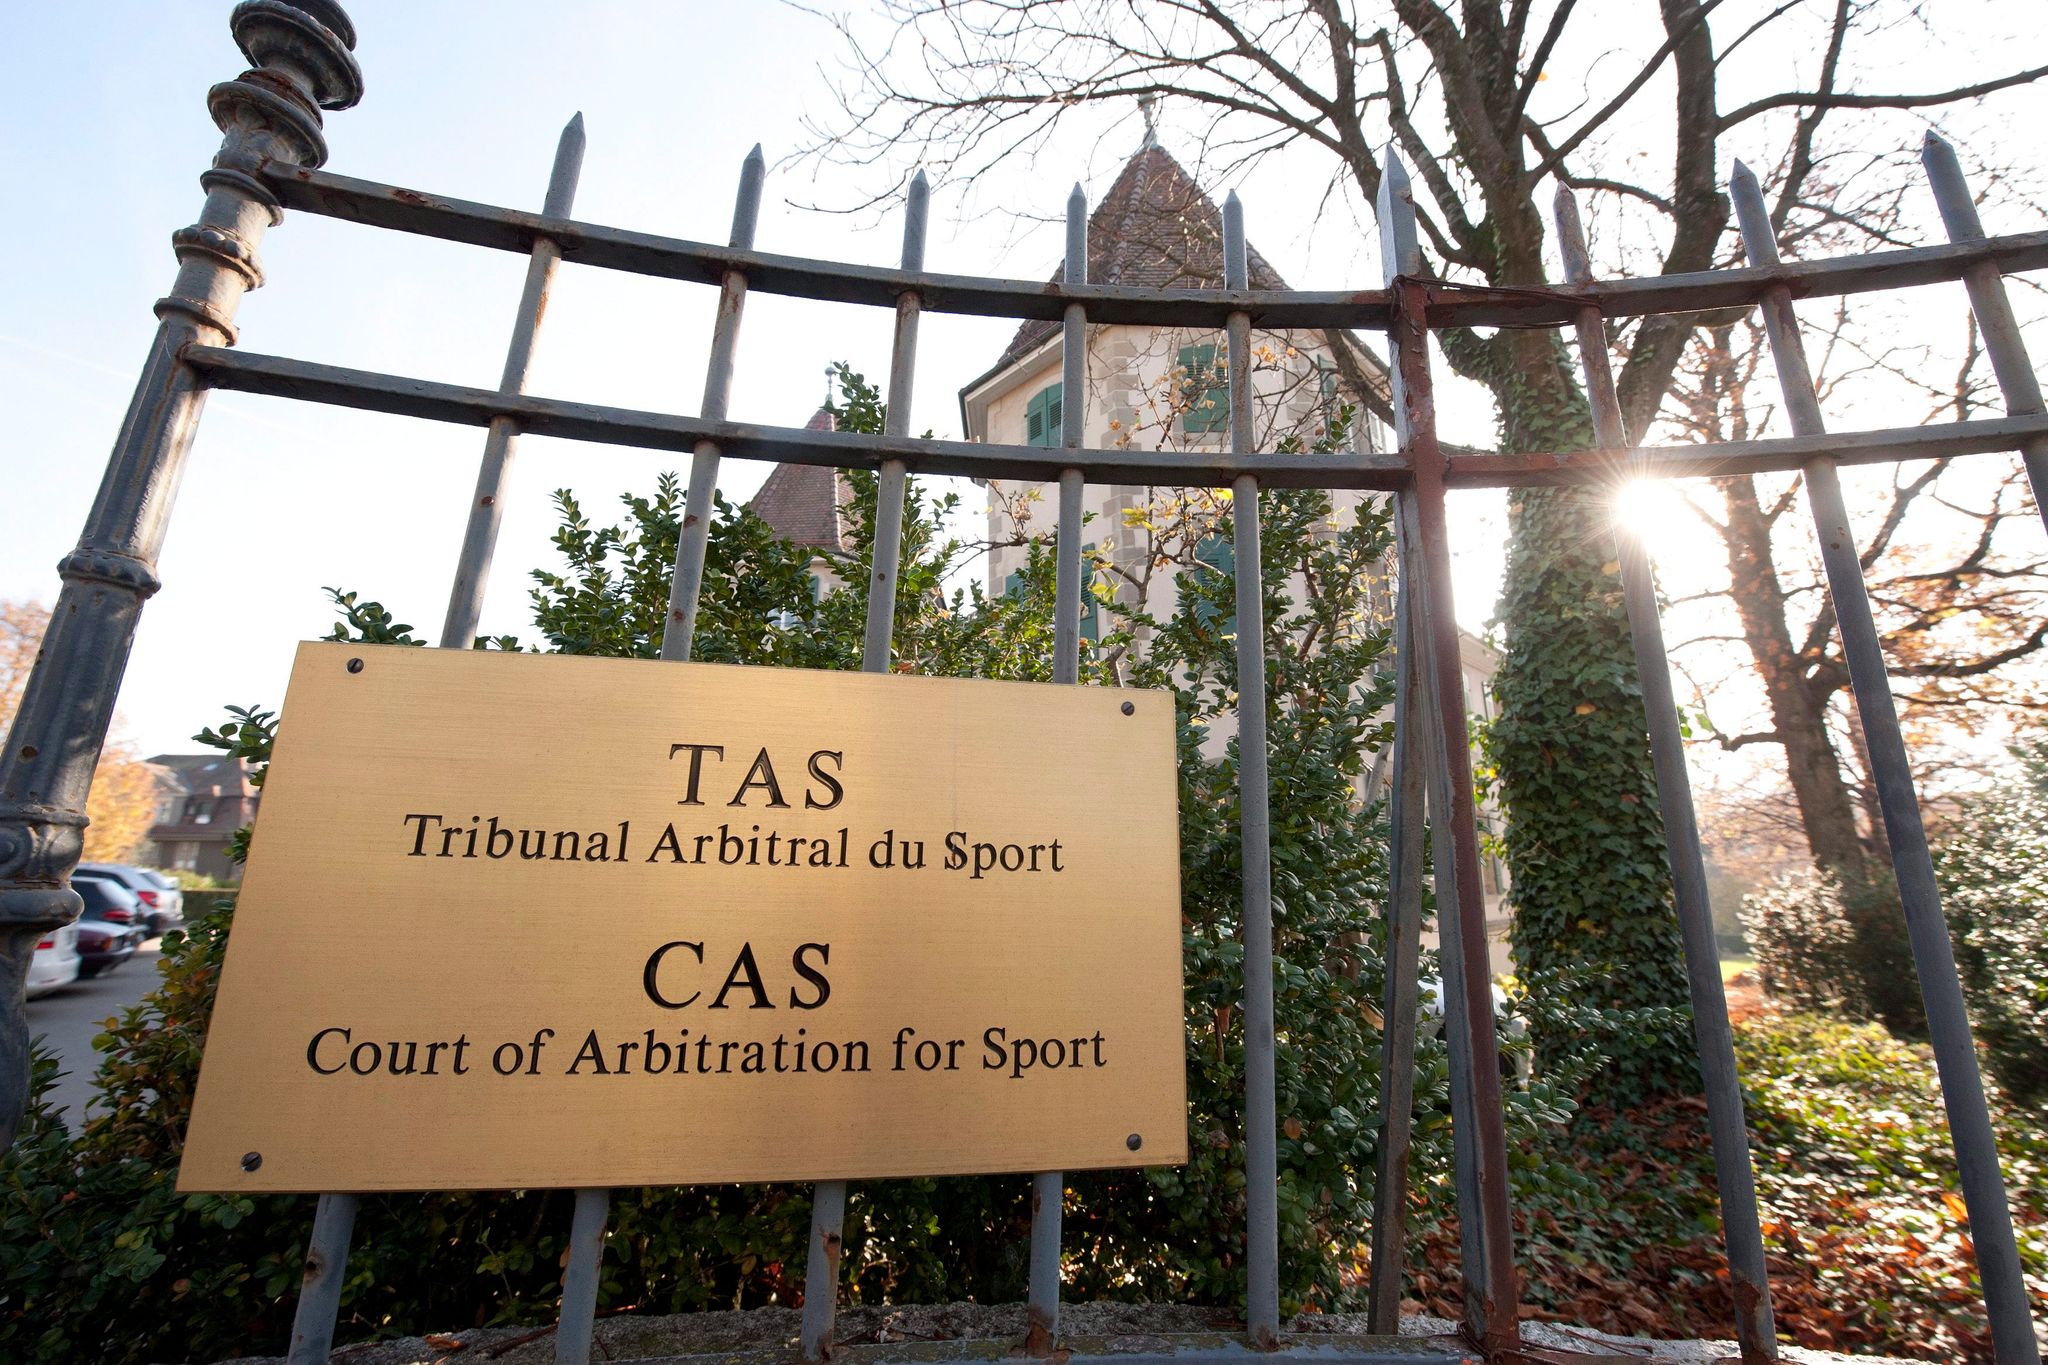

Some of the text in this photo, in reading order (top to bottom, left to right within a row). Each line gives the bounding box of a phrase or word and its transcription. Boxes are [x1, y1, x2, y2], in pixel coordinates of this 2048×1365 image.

[670, 744, 844, 810] TAS
[403, 814, 1065, 880] Tribunal Arbitral du Sport
[643, 941, 831, 1010] CAS
[306, 1027, 1108, 1079] Court of Arbitration for Sport
